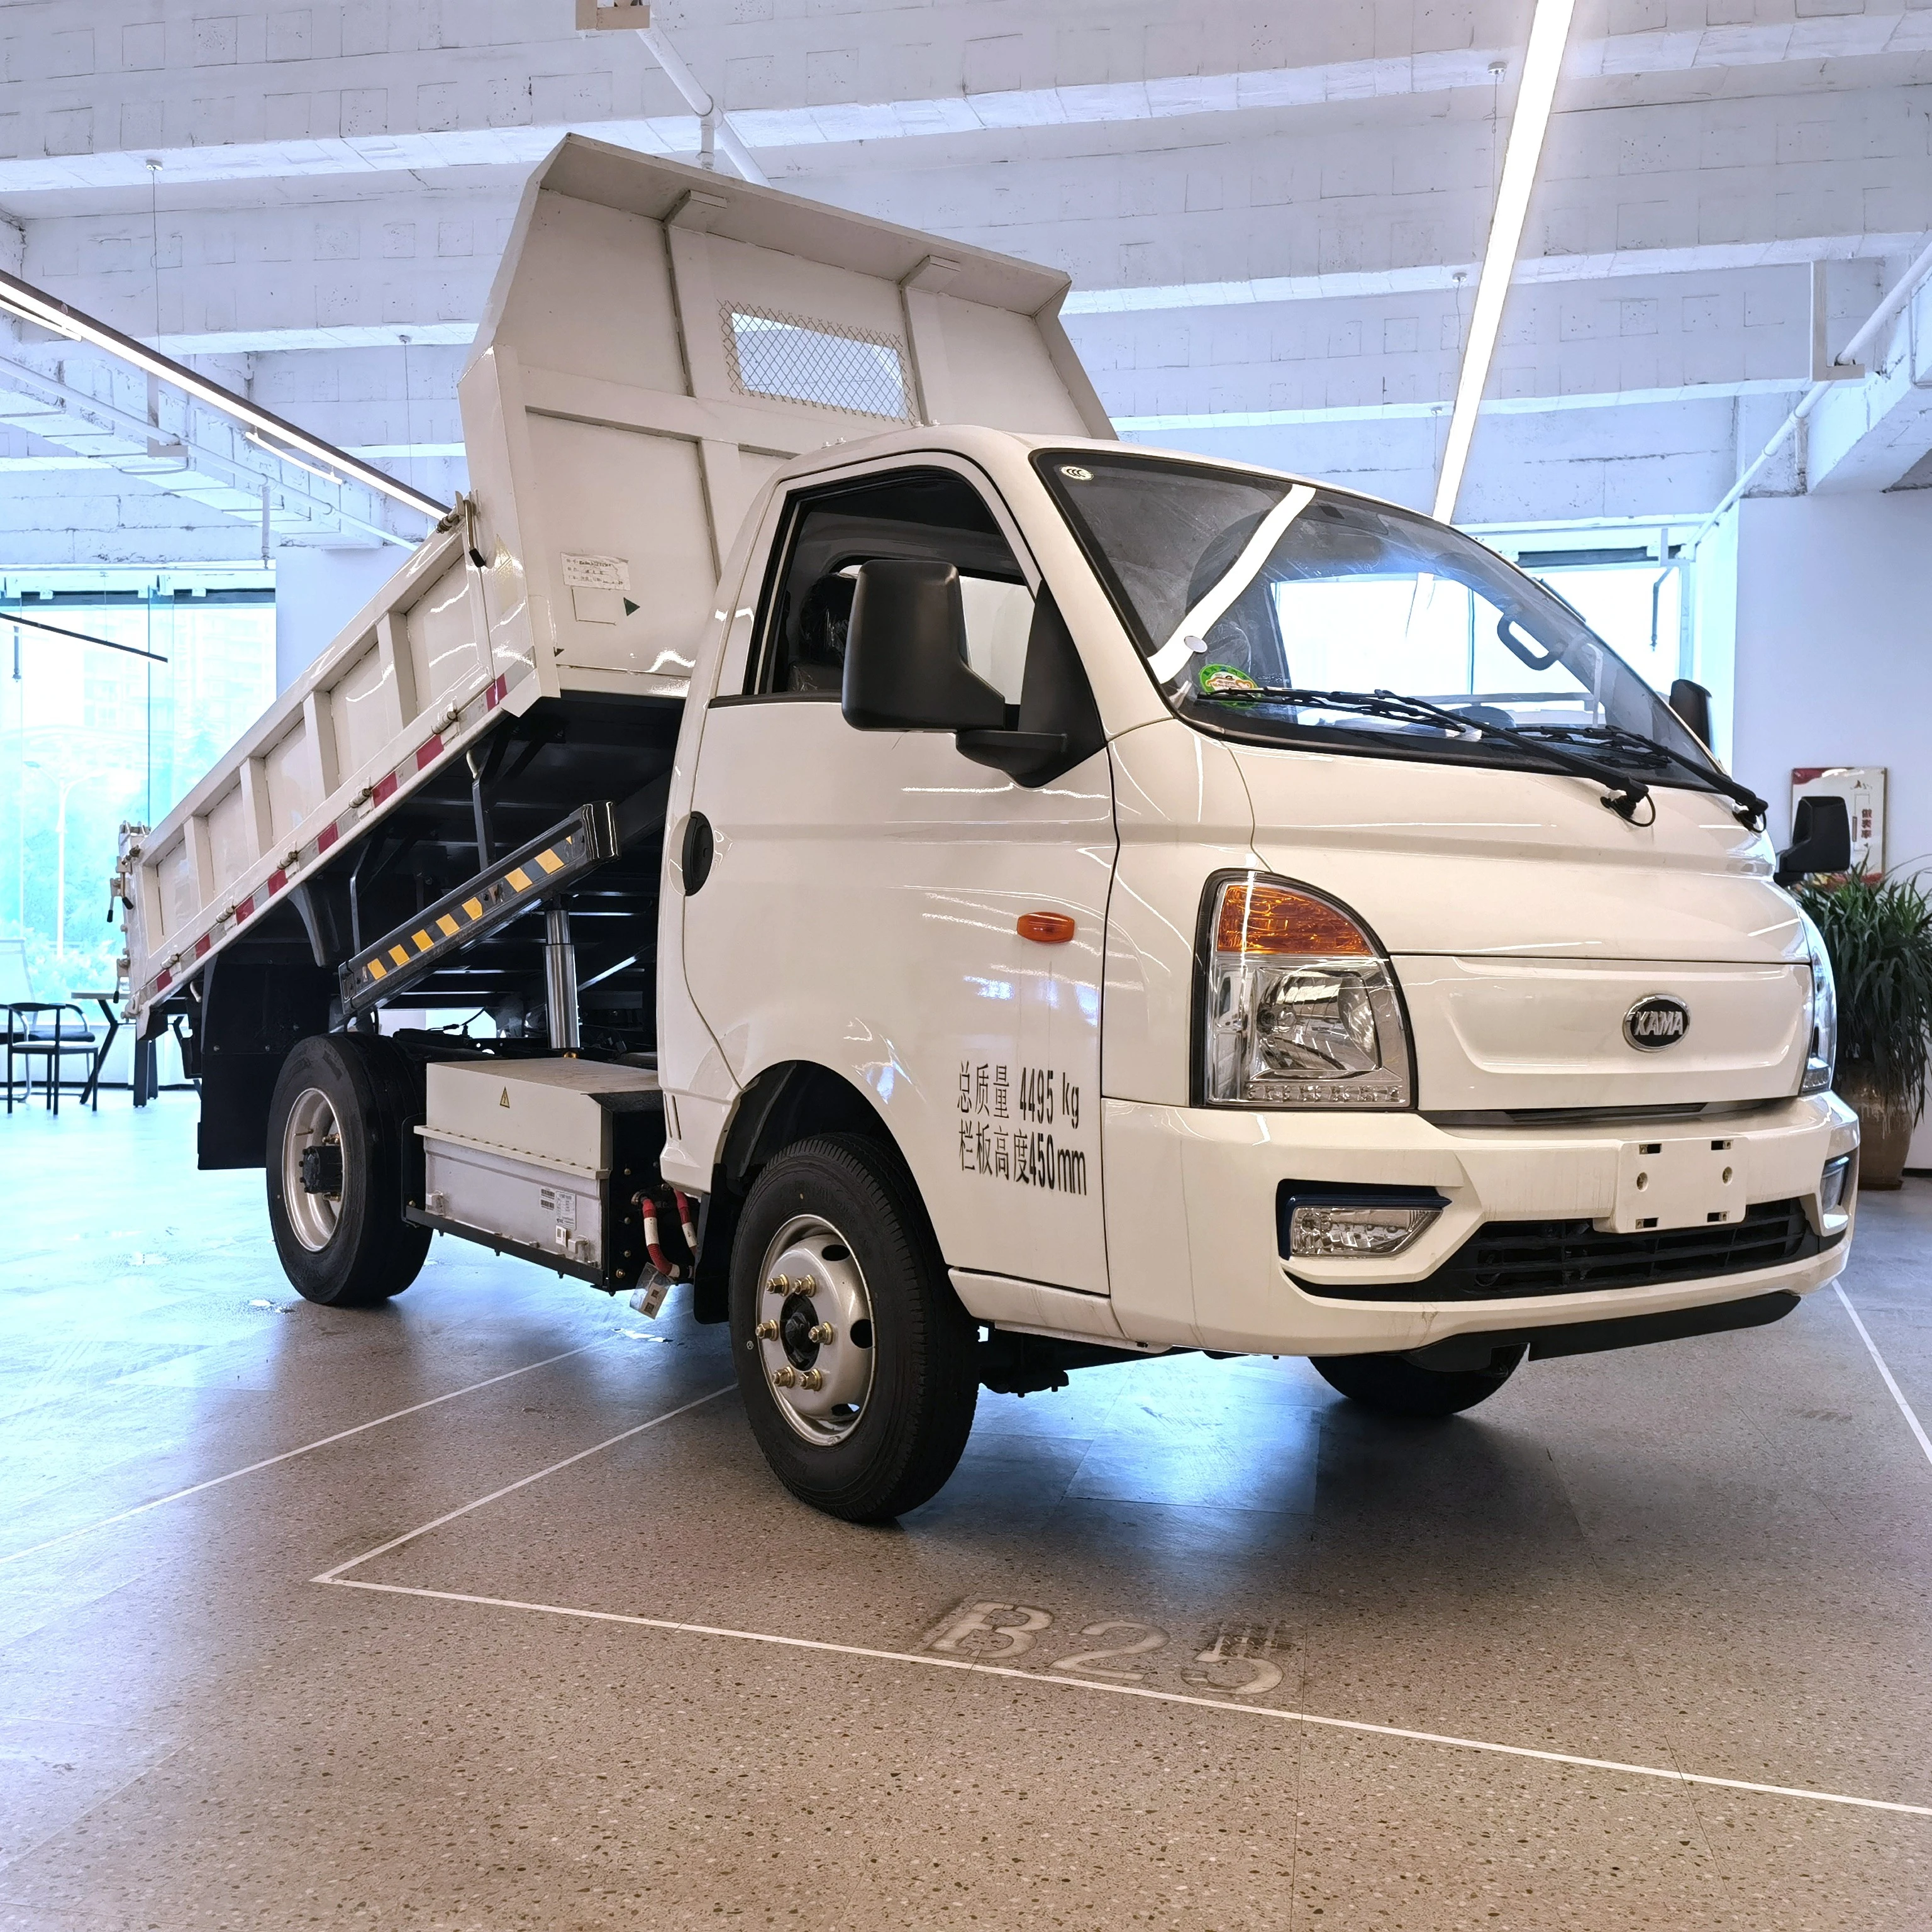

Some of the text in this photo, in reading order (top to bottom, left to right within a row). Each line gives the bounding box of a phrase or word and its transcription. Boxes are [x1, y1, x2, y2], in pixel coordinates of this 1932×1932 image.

[1633, 1010, 1684, 1036] KAMA
[957, 1060, 1079, 1130] 总质量 4495 kg
[958, 1118, 1087, 1196] 栏板高度450mm
